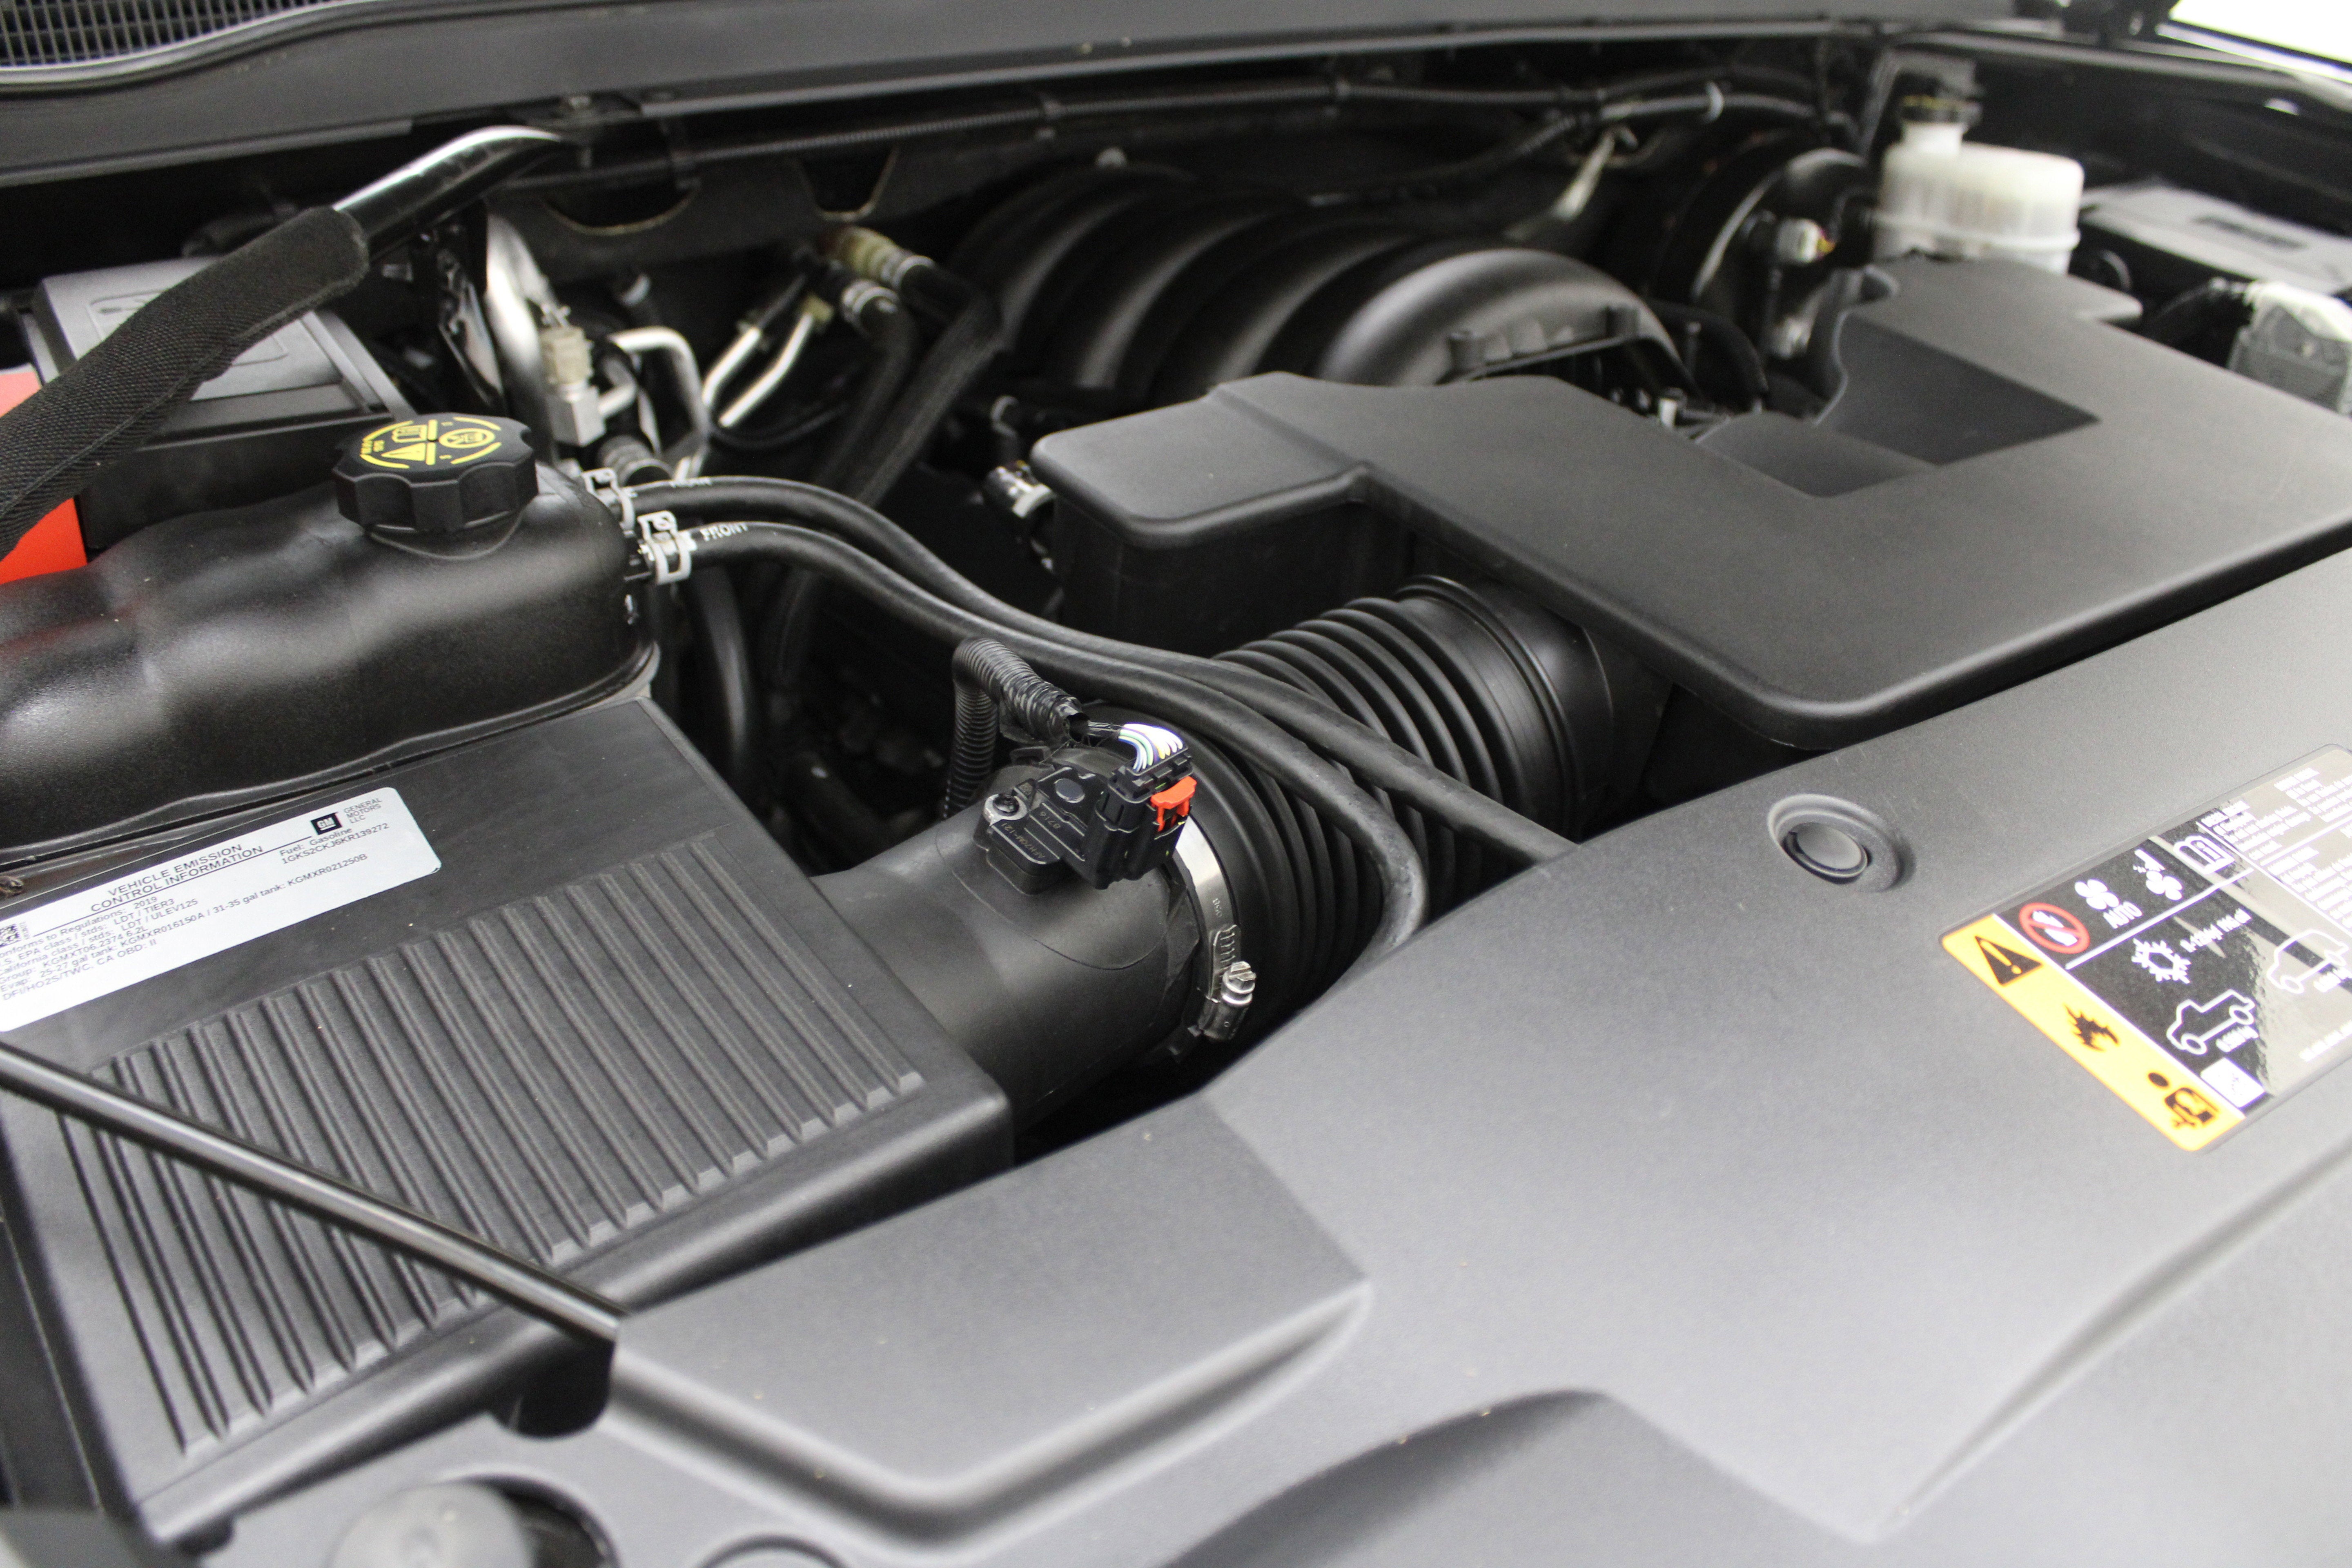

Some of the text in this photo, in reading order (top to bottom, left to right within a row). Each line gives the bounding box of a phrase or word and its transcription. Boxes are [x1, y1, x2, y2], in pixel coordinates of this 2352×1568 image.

[699, 522, 748, 541] FRONT
[343, 797, 383, 813] GENERAL
[346, 804, 381, 818] MOTORS
[316, 817, 335, 828] GM
[350, 815, 366, 824] LLC
[279, 828, 352, 856] Fuel: Gasoline
[91, 846, 263, 912] CONTROL INFORMATION
[108, 844, 243, 896] VEHICLE EMISSION
[0, 977, 31, 992] Evap:
[40, 962, 68, 978] 25-27
[72, 954, 88, 967] gal
[91, 946, 118, 958] tank:
[120, 912, 205, 947] KGMXR016150A
[212, 899, 241, 914] 31-35
[243, 892, 259, 904] gal
[260, 883, 286, 897] tank:
[287, 853, 368, 886] KGMXR021250B
[0, 939, 44, 958] onforms
[60, 909, 126, 935] Regulations:
[134, 896, 157, 909] 2019
[18, 948, 40, 960] EPA
[44, 937, 72, 950] class
[81, 924, 107, 937] stds:
[114, 913, 134, 925] LDT
[143, 898, 175, 913] TIER3
[2103, 901, 2143, 929] AUTO
[0, 954, 48, 976] alifornia
[51, 943, 79, 956] class
[89, 930, 114, 943] stds:
[121, 918, 142, 931] LDT
[151, 899, 198, 920] ULEV125
[126, 926, 148, 937] 6.2L
[97, 955, 114, 965] CA
[117, 944, 147, 958] OBD:
